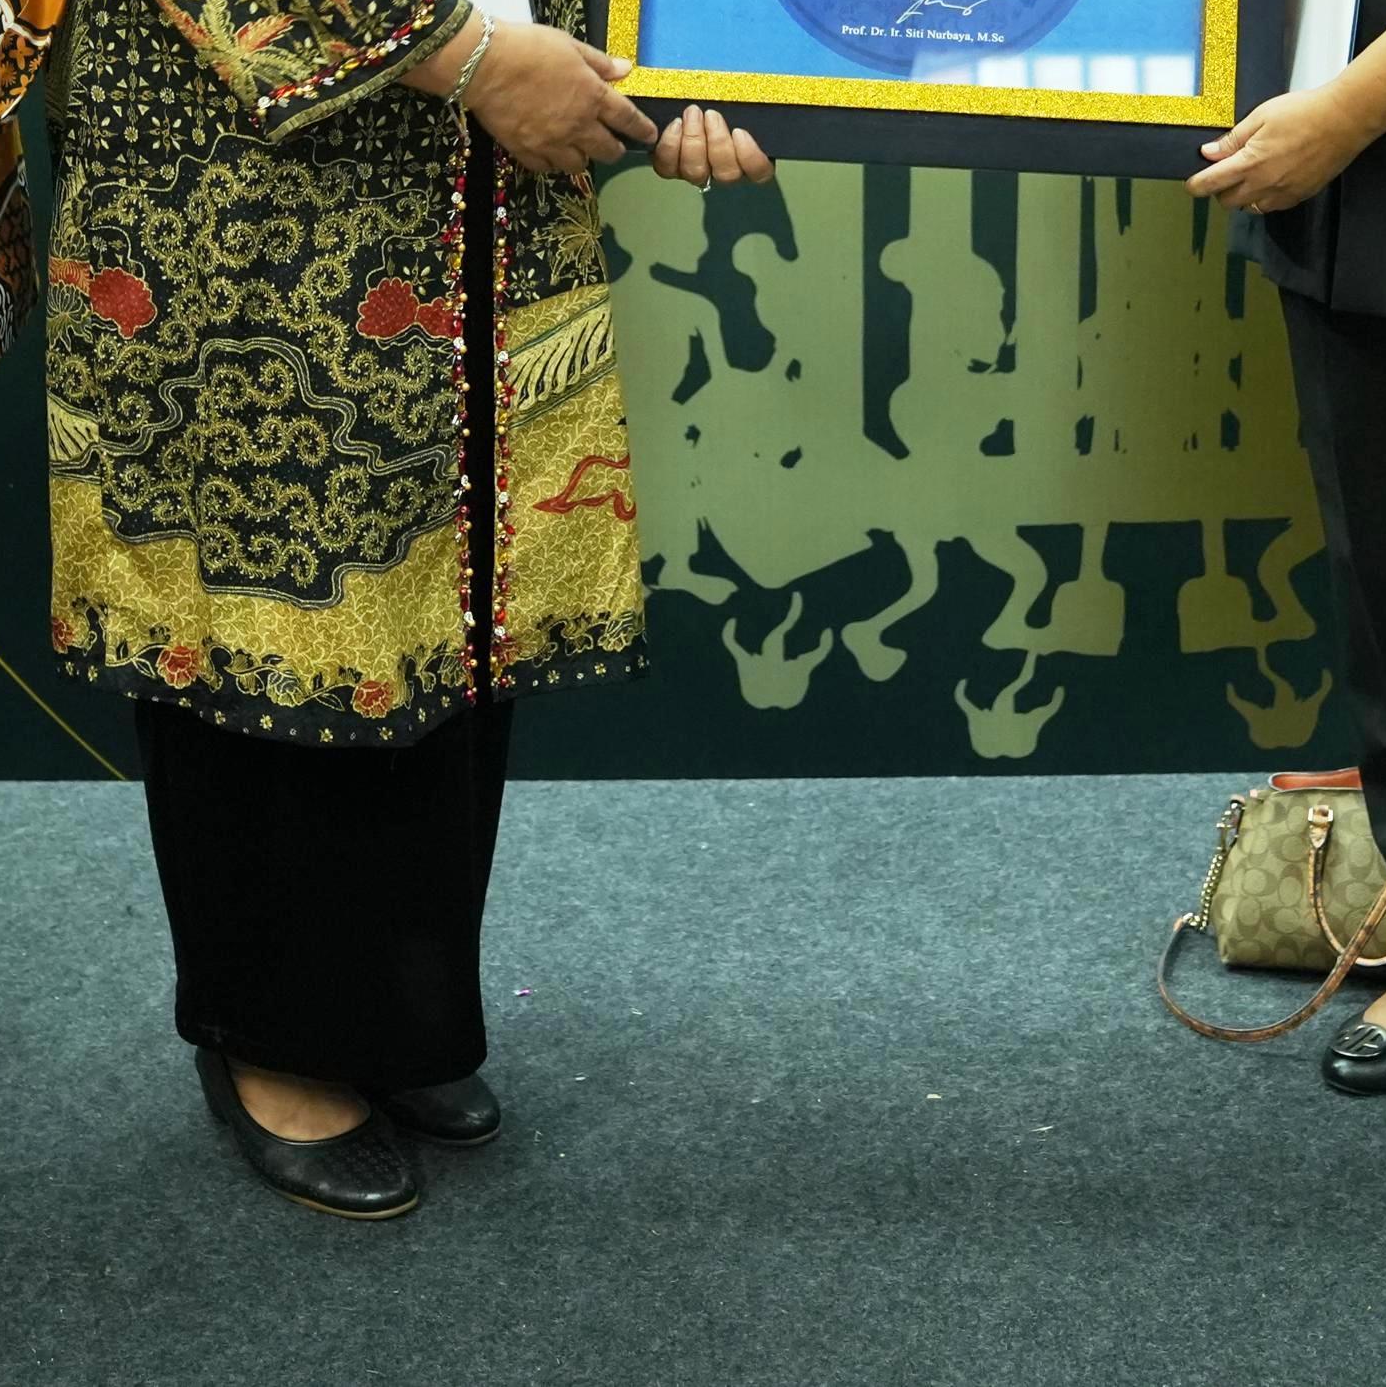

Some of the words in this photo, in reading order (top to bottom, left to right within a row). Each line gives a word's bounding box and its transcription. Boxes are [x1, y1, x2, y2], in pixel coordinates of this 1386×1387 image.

[841, 25, 867, 36] Prof.
[871, 26, 888, 37] Dr.
[890, 27, 903, 38] Ir.
[905, 28, 924, 39] Siti
[927, 29, 974, 43] Nurbaya,
[977, 31, 1005, 43] M.Sc
